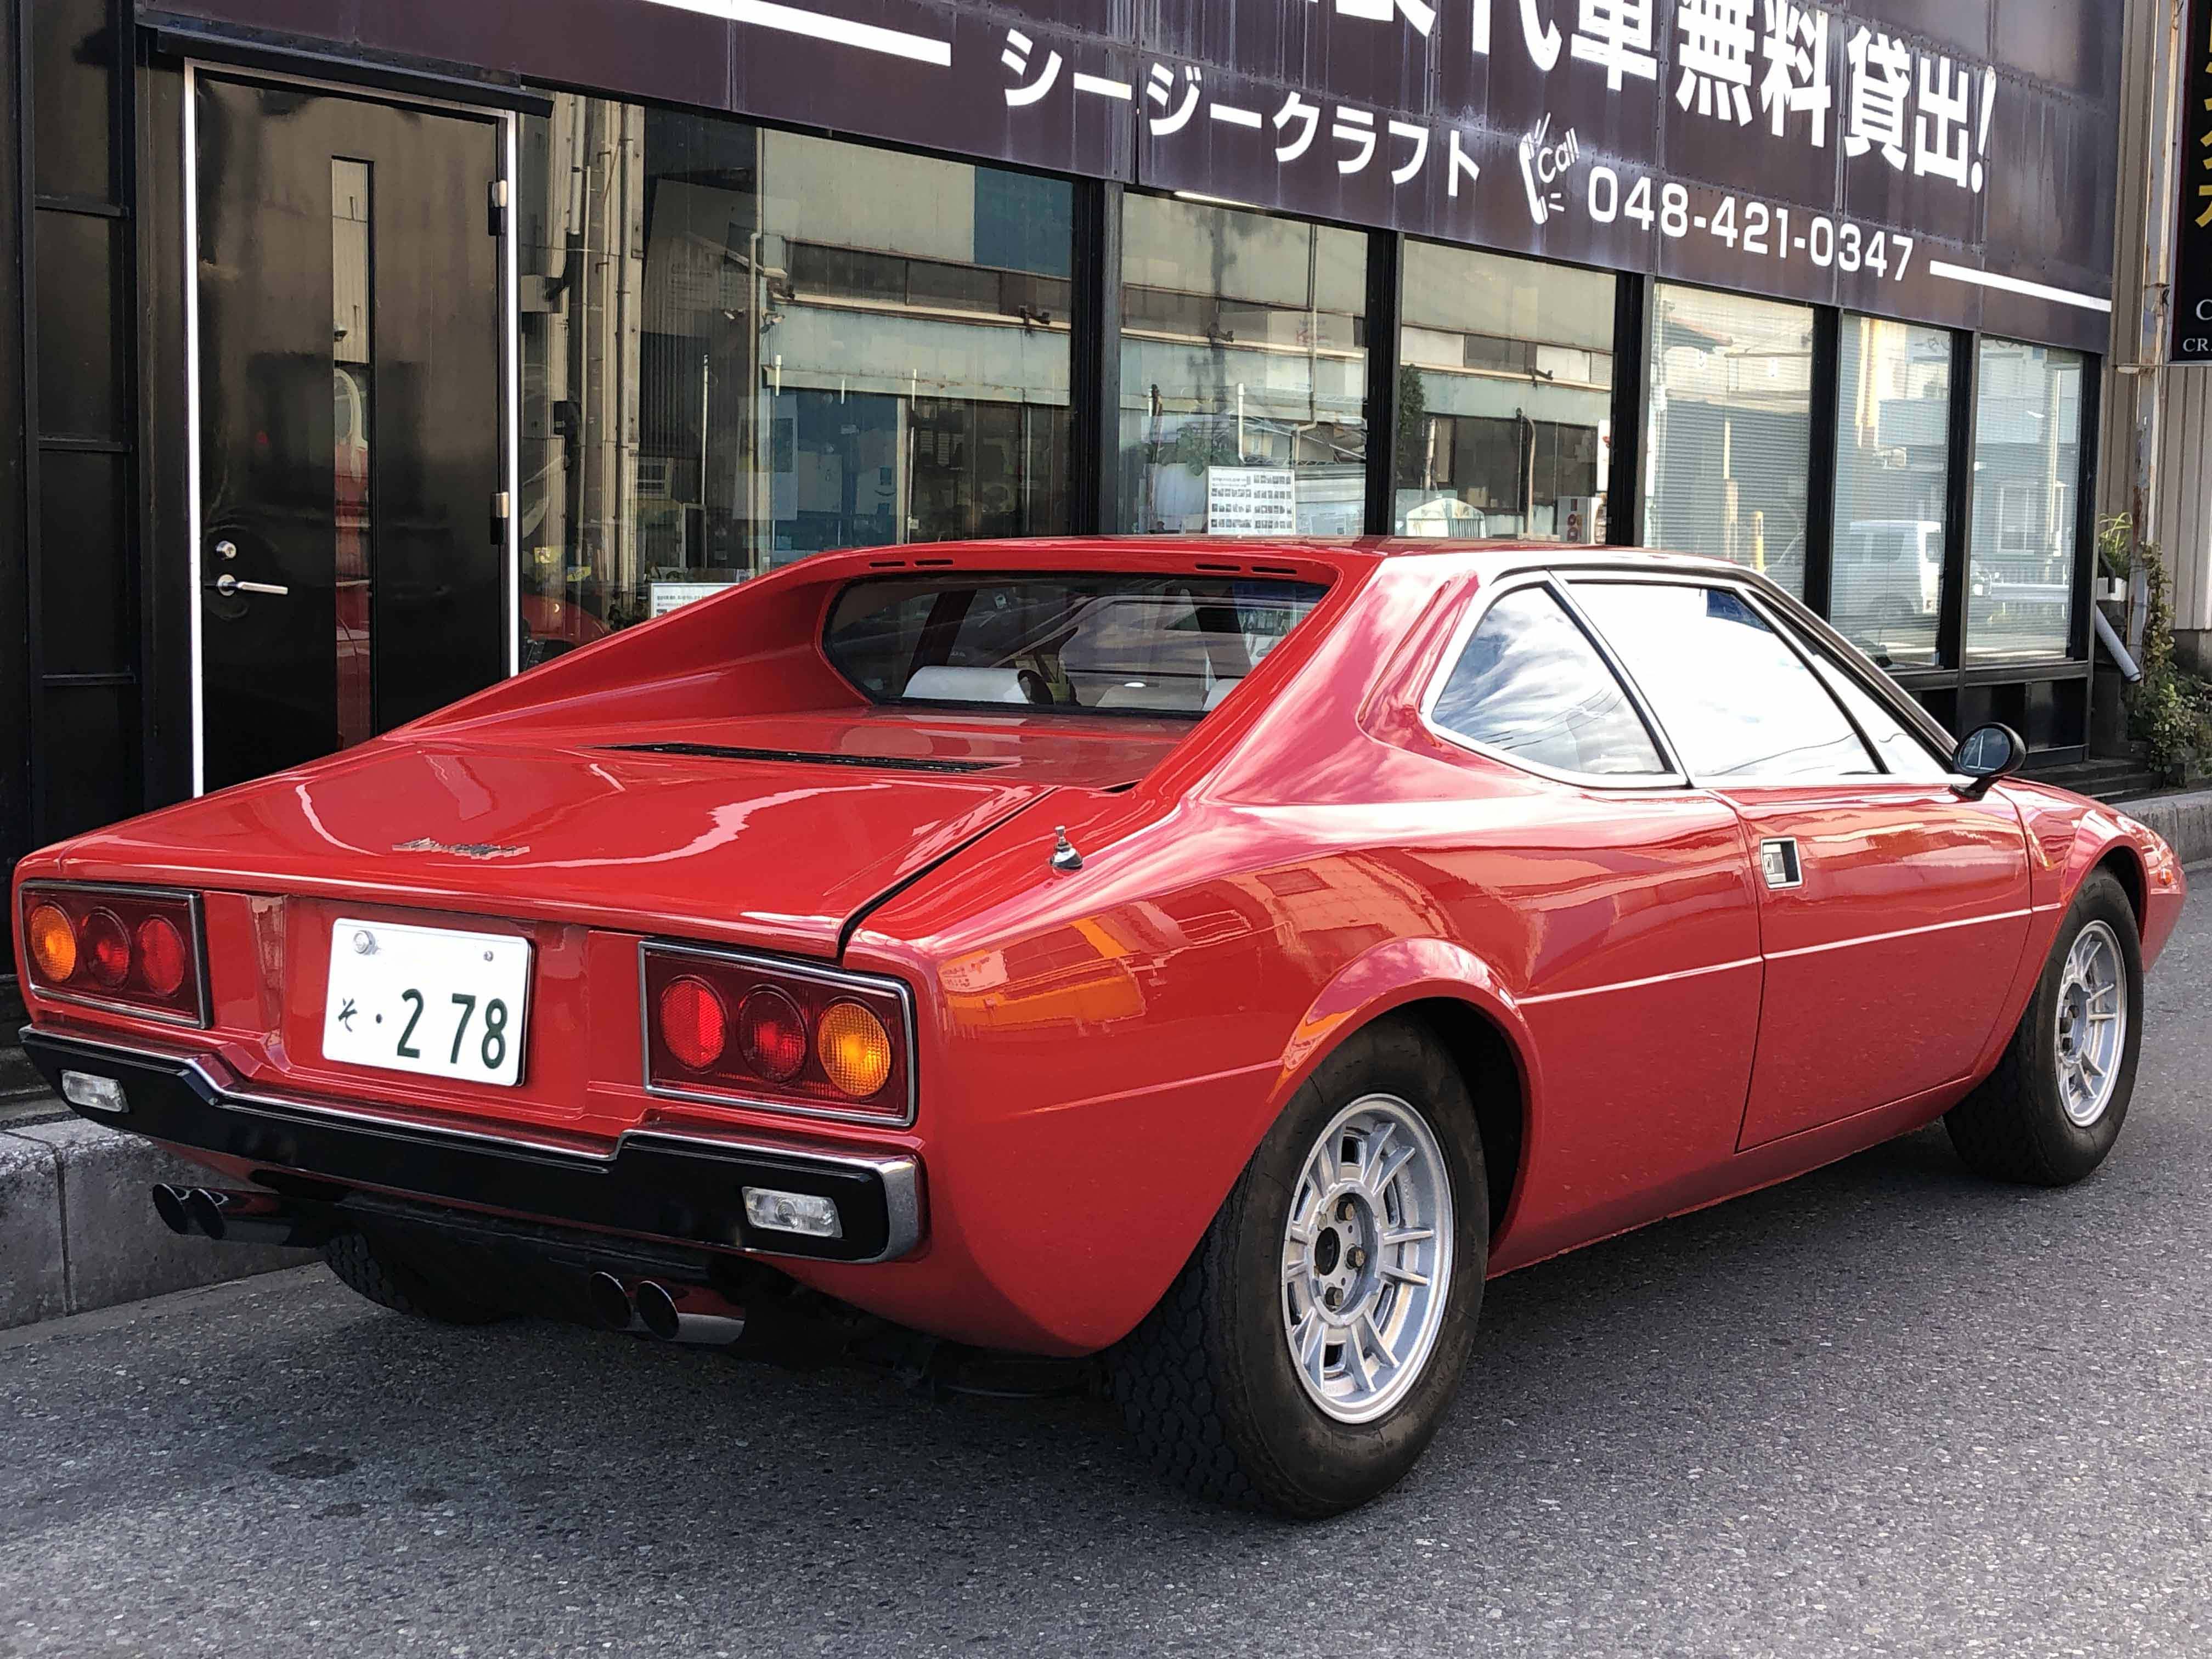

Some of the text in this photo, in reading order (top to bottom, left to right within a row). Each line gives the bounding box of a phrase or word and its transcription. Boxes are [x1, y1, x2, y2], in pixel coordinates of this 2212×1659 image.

[1001, 29, 1480, 196] シージークラフト
[1538, 128, 1581, 183] Call
[1588, 166, 1914, 281] 048-421-0347
[2183, 338, 2212, 352] CR
